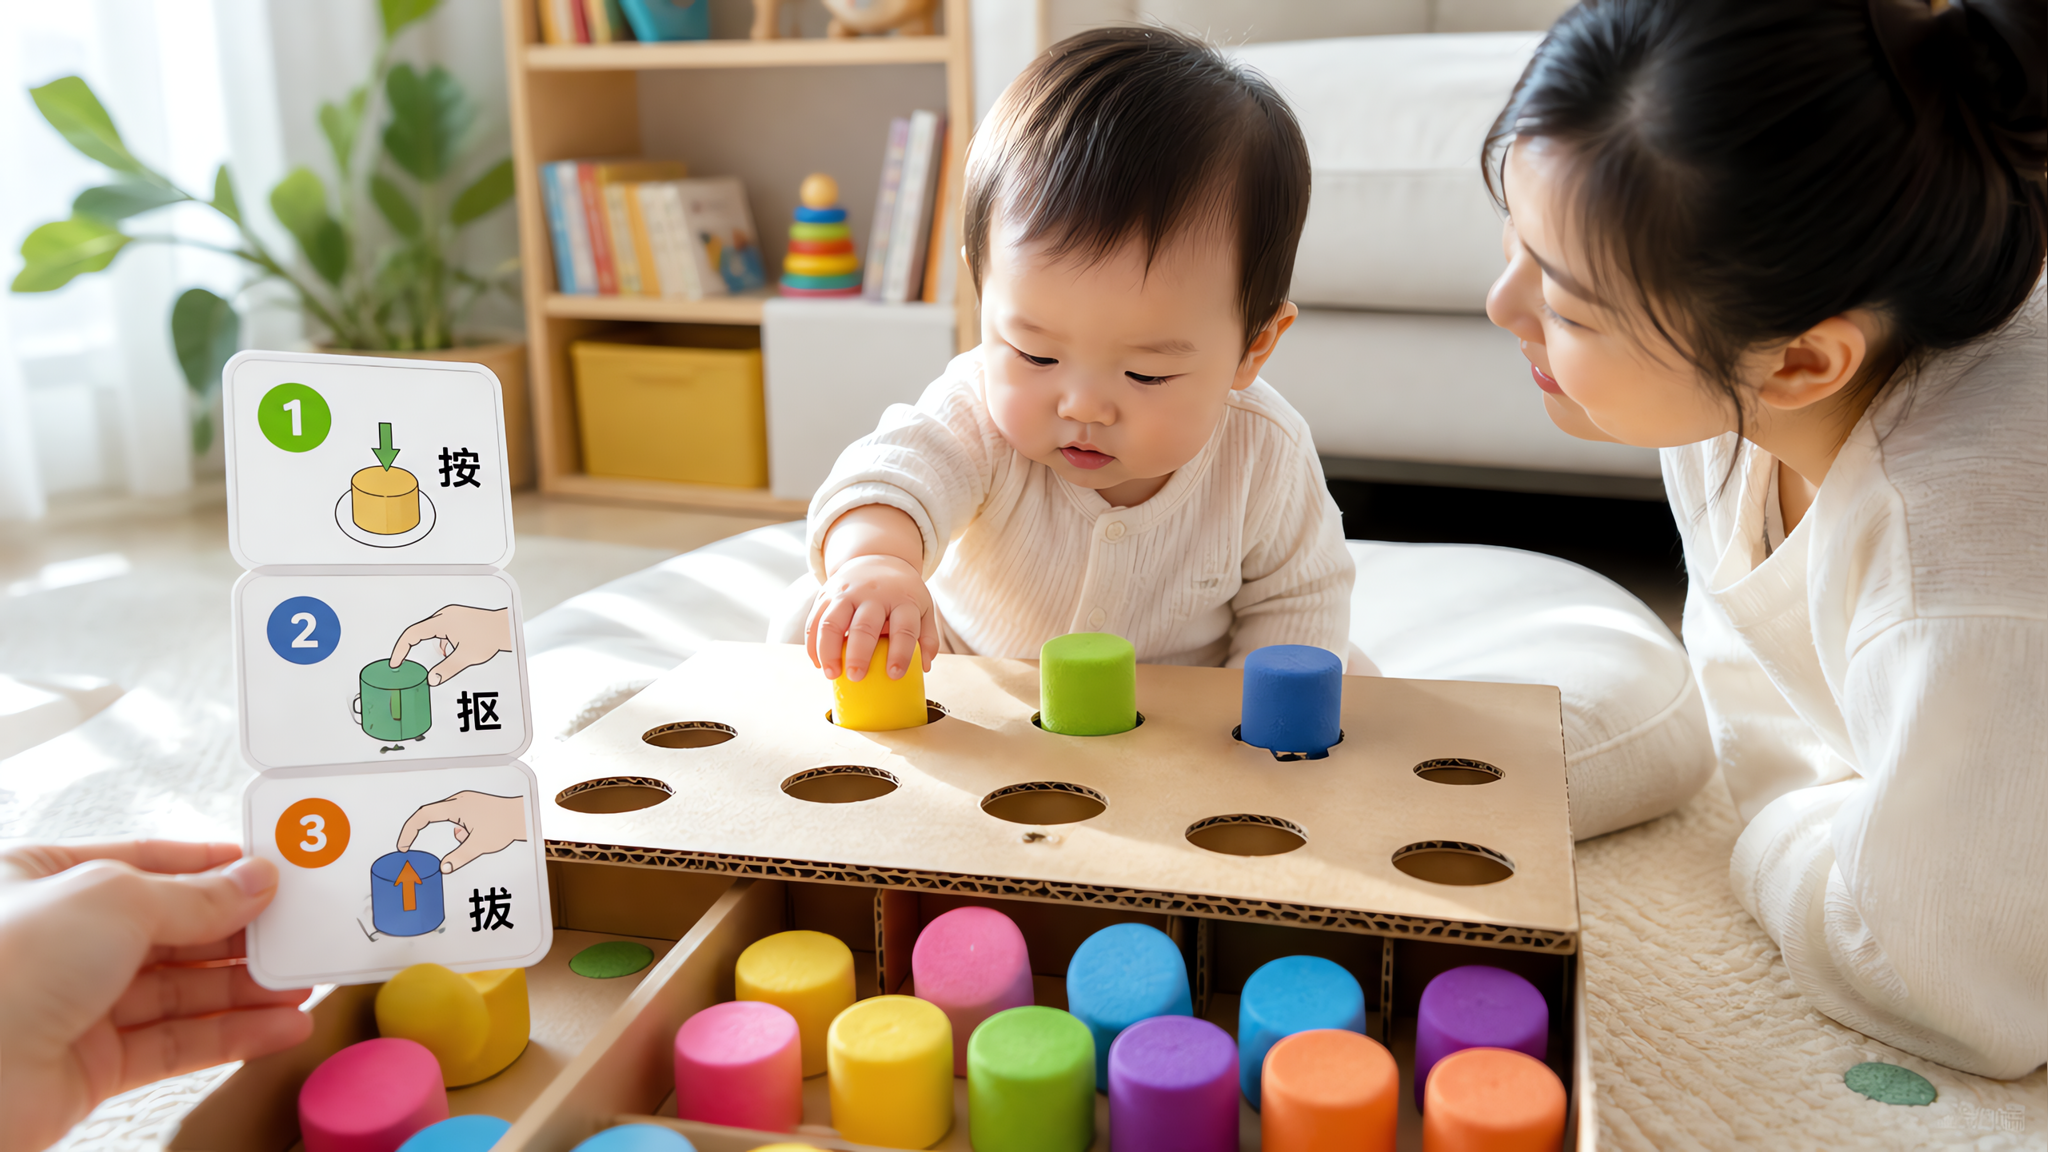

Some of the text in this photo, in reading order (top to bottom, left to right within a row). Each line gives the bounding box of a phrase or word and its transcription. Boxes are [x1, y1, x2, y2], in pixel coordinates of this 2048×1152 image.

[282, 399, 302, 437] 1
[438, 446, 482, 489] 按
[290, 611, 319, 649] 2
[456, 690, 502, 733] 抠
[299, 813, 328, 853] 3
[468, 886, 515, 933] 拔
